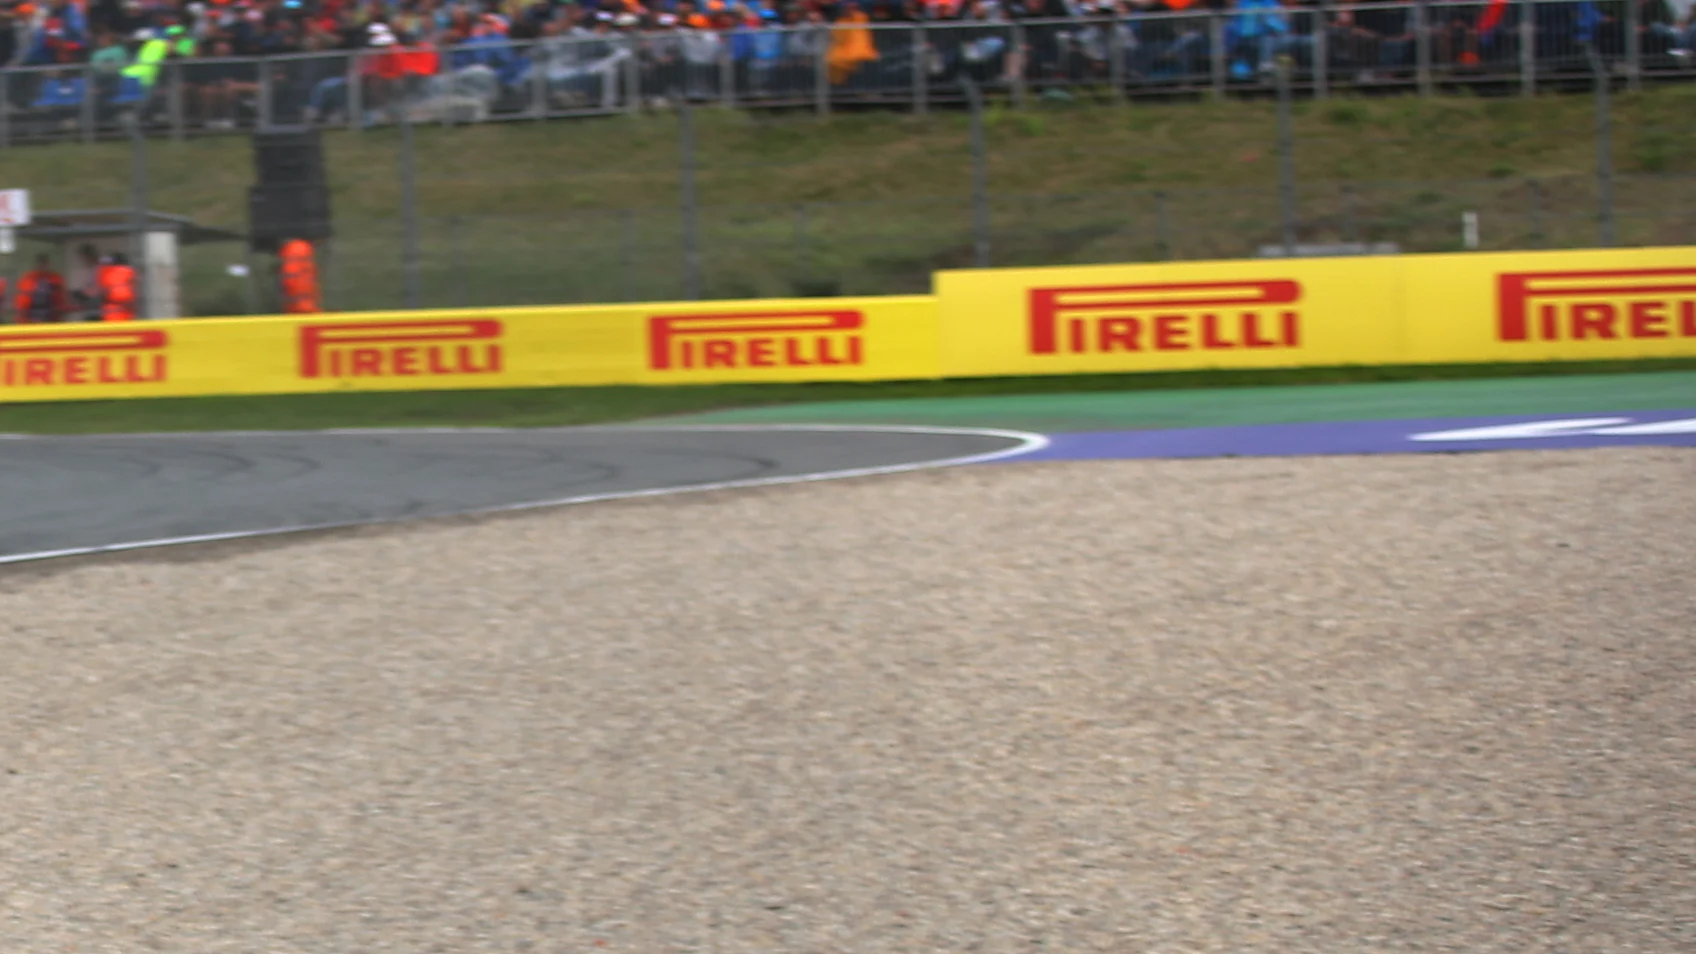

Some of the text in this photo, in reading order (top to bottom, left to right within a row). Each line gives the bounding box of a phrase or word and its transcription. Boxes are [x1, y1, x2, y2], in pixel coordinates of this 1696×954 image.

[1027, 278, 1302, 355] PIRELLI
[1496, 267, 1695, 342] PIREL
[298, 318, 504, 378] PIRELLI
[647, 309, 865, 370] PIRELLI
